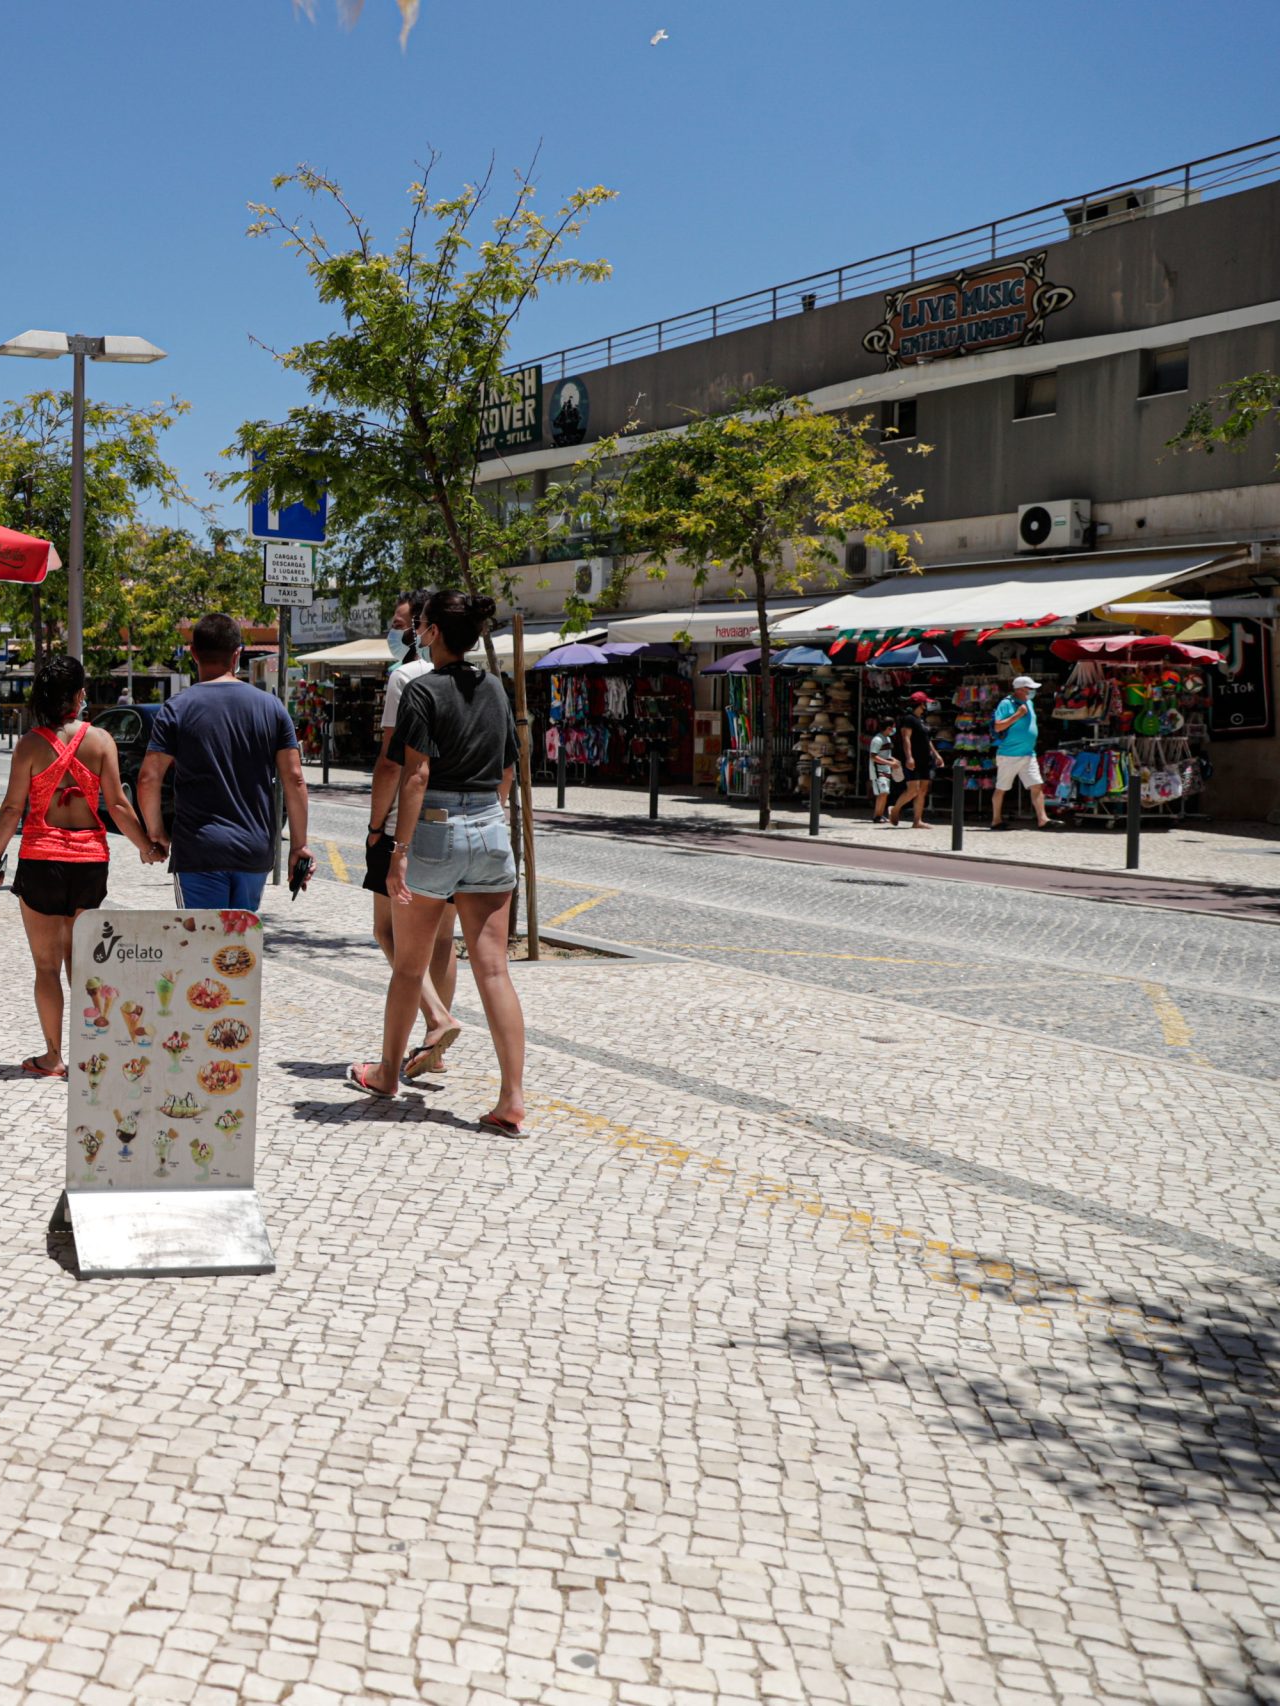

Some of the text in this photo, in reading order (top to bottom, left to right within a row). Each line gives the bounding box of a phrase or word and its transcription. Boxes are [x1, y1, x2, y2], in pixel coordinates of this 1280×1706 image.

[901, 277, 1026, 330] LIVE MUSIC
[900, 312, 1027, 358] ENTERTAINMENT
[117, 944, 162, 963] gelato
